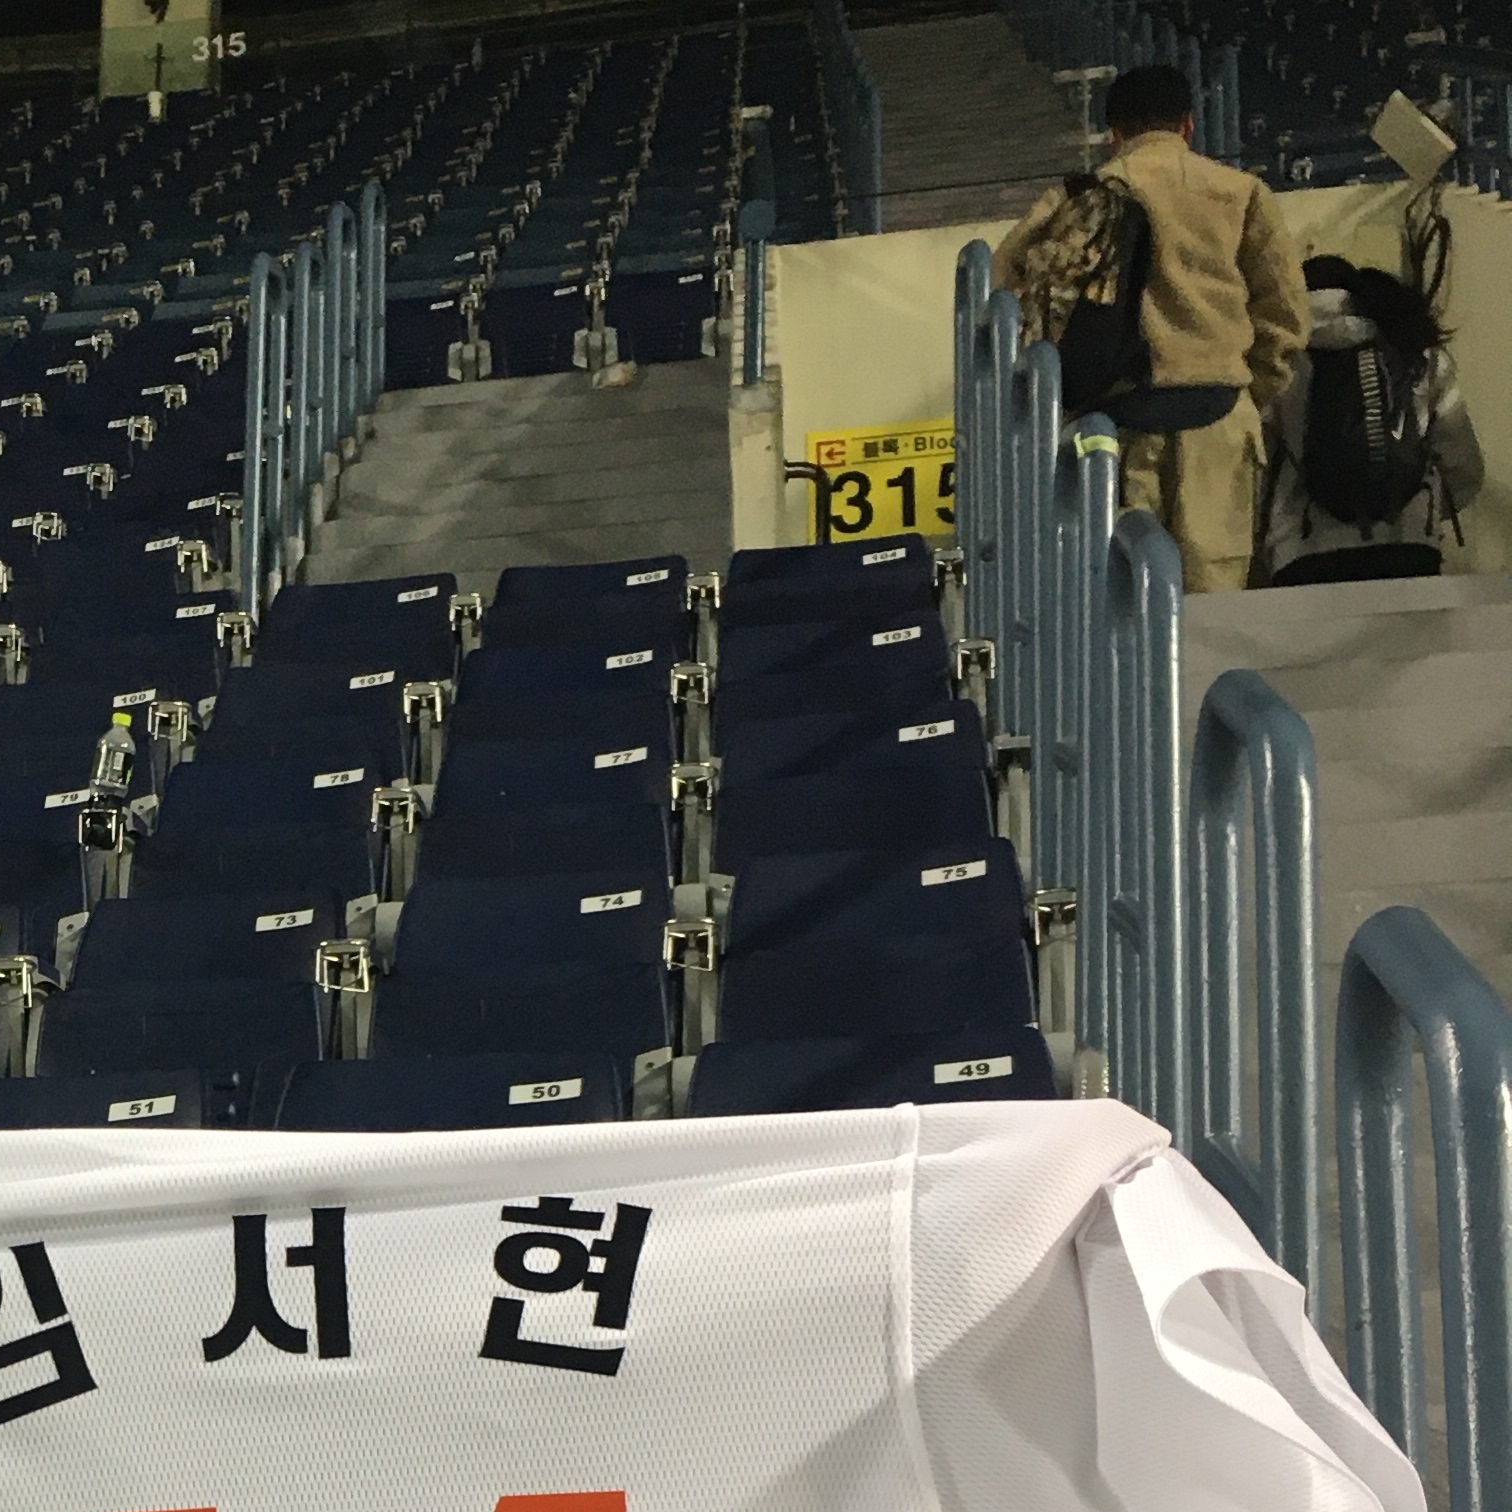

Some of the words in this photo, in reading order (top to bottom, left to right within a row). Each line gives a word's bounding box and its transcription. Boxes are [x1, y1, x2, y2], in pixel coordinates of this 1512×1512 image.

[192, 32, 247, 61] 315
[915, 435, 955, 451] Blo
[184, 606, 208, 616] 107
[882, 630, 912, 642] 103
[616, 653, 645, 666] 102
[359, 674, 385, 686] 101
[121, 693, 147, 704] 100
[915, 724, 939, 737] 76
[611, 752, 633, 764] 77
[330, 773, 350, 784] 78
[60, 792, 79, 803] 79
[942, 866, 968, 880] 75
[599, 895, 625, 909] 74
[274, 914, 297, 927] 73
[959, 1063, 990, 1076] 49
[532, 1085, 560, 1098] 50
[129, 1102, 154, 1115] 51
